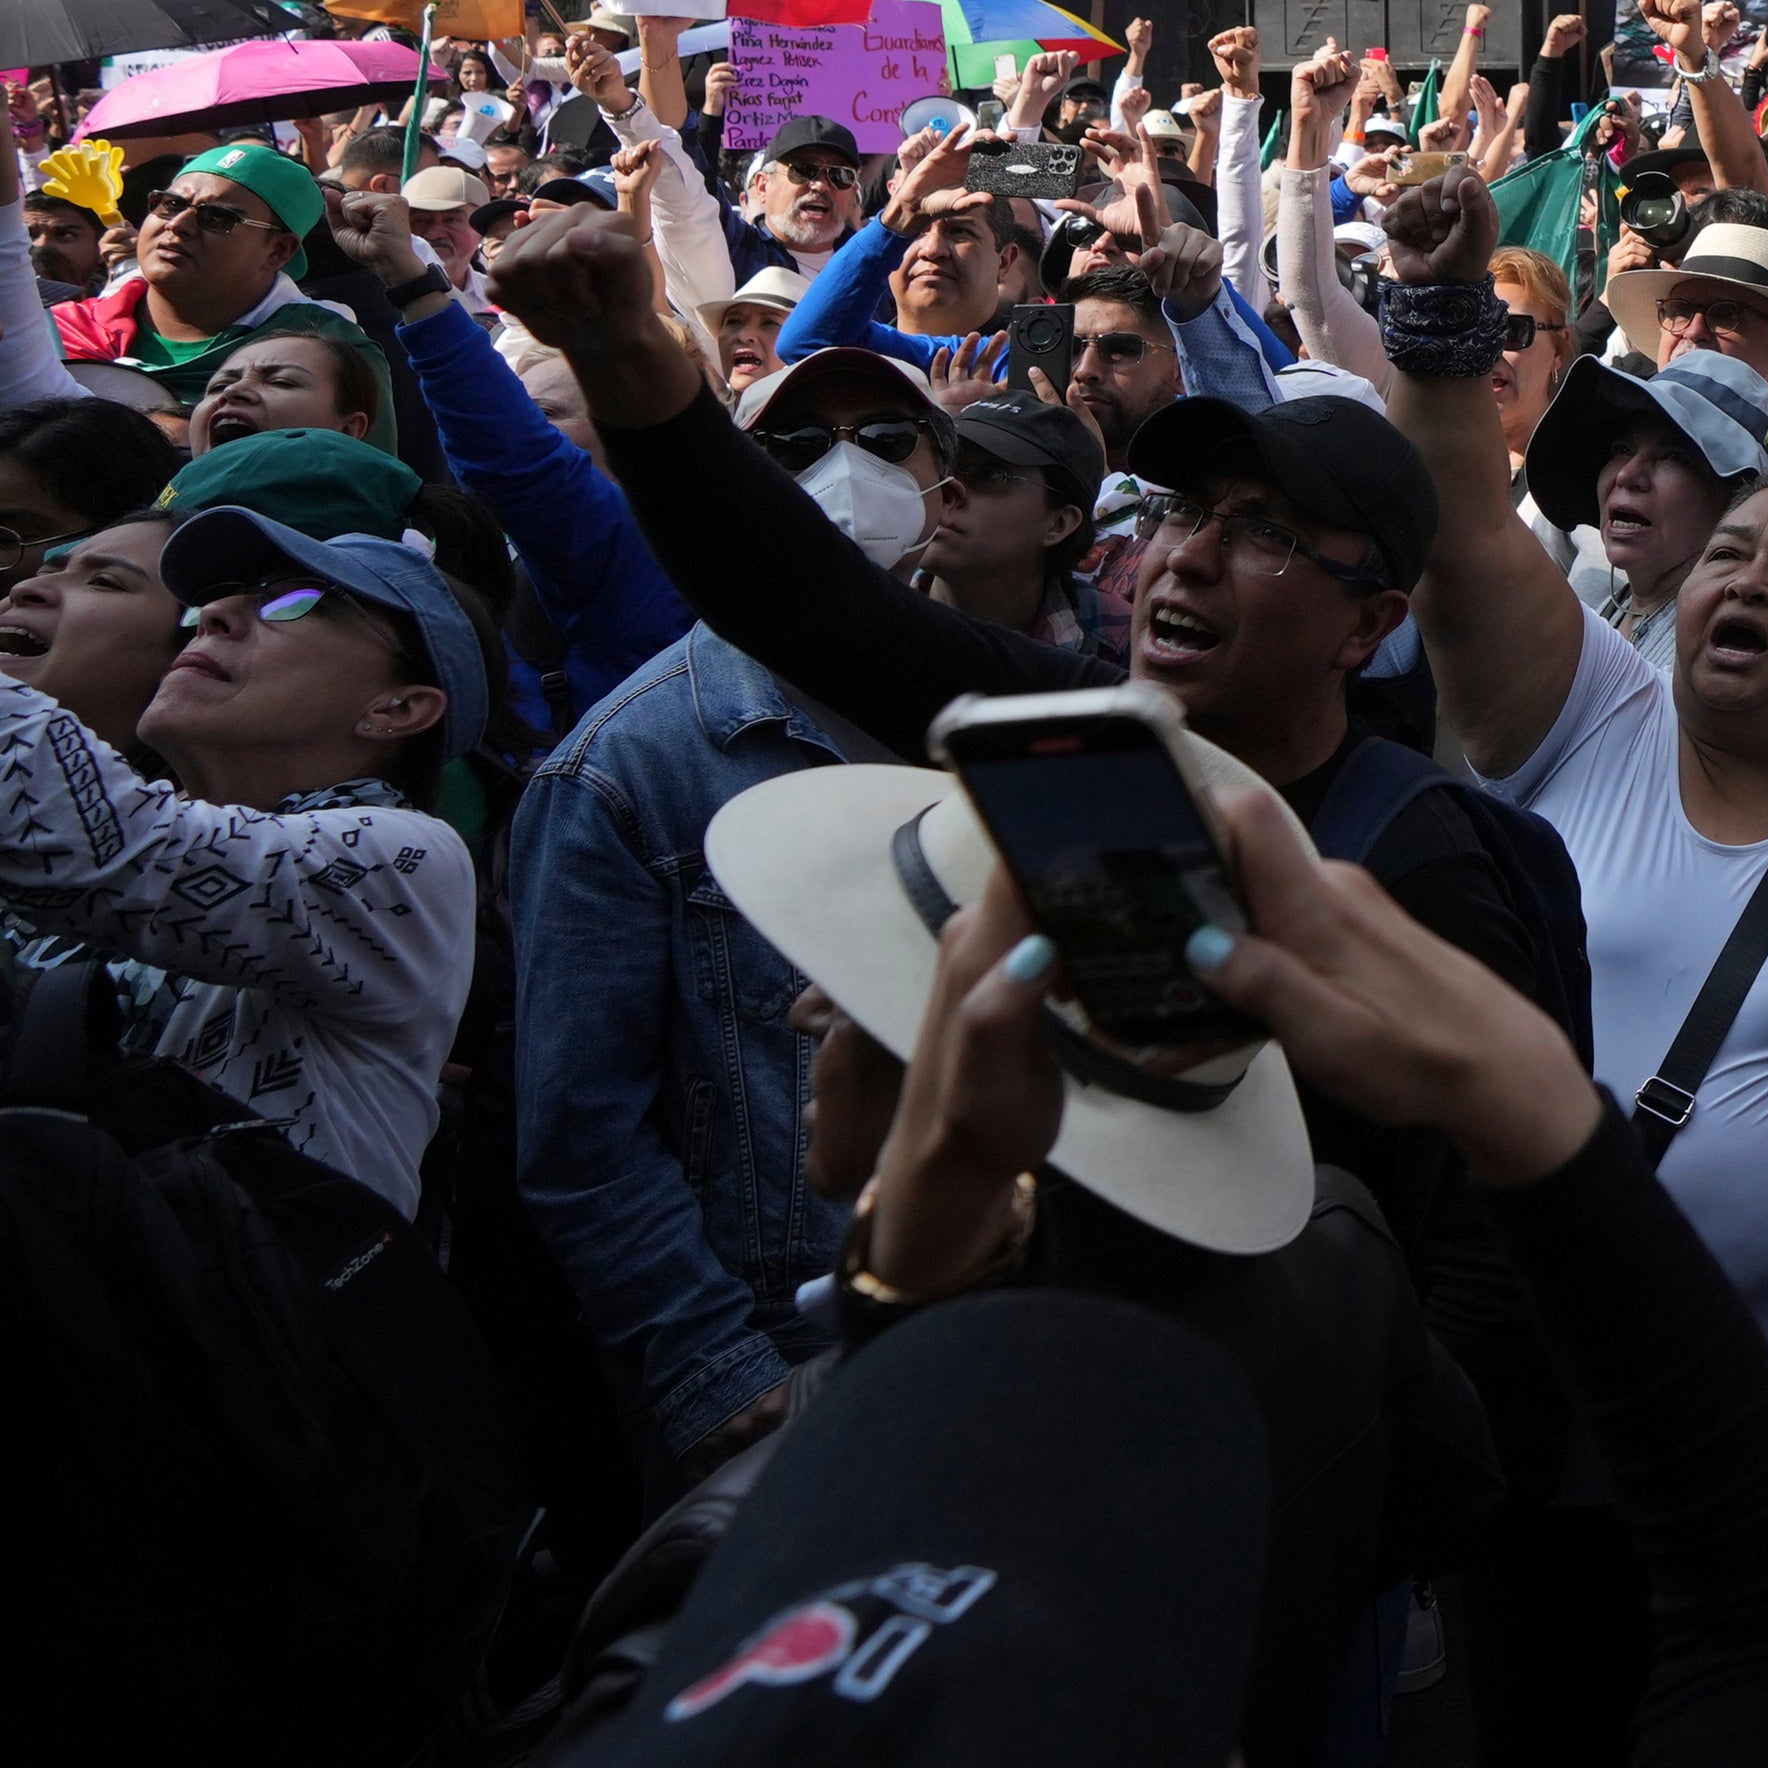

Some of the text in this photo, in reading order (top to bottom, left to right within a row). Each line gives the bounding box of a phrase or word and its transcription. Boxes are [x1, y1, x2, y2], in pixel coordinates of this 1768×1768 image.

[731, 31, 834, 51] Piña Hernández
[880, 55, 928, 81] de la
[728, 89, 804, 111] Ríos Farjat
[726, 109, 776, 126] Ortiz
[324, 1241, 385, 1291] TechZone
